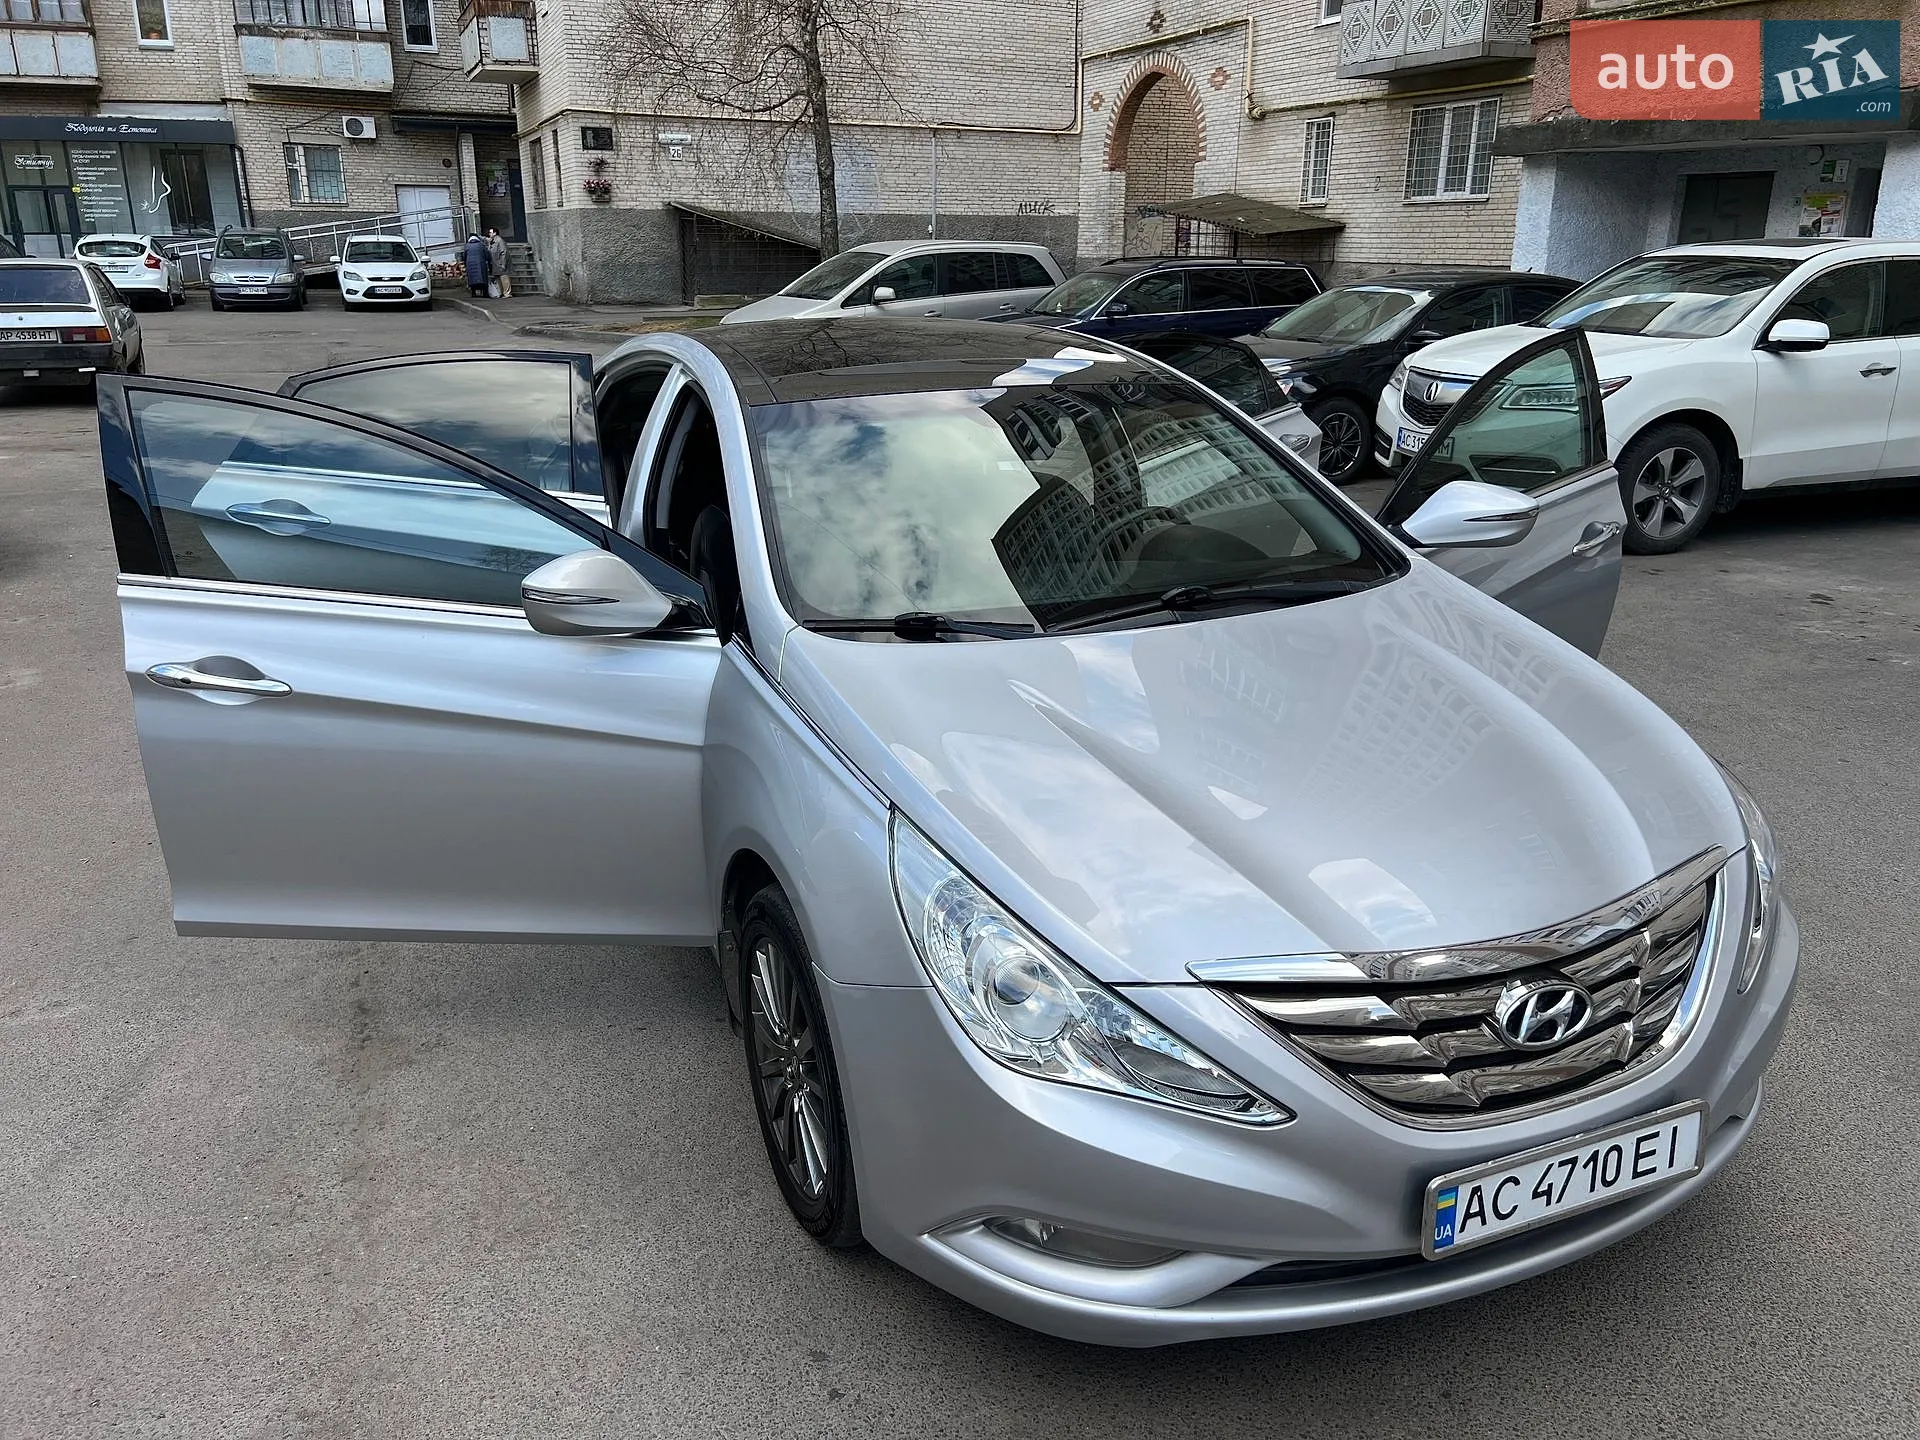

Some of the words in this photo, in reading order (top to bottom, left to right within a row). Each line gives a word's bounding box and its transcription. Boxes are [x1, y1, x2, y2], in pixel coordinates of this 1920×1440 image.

[671, 148, 682, 159] 26
[0, 330, 13, 340] AP
[15, 330, 37, 340] 4538
[38, 330, 52, 340] HT
[1402, 433, 1411, 447] AC
[1459, 1175, 1521, 1234] AC
[1531, 1144, 1623, 1207] 4710
[1631, 1125, 1679, 1180] EI
[1434, 1223, 1452, 1240] UA
